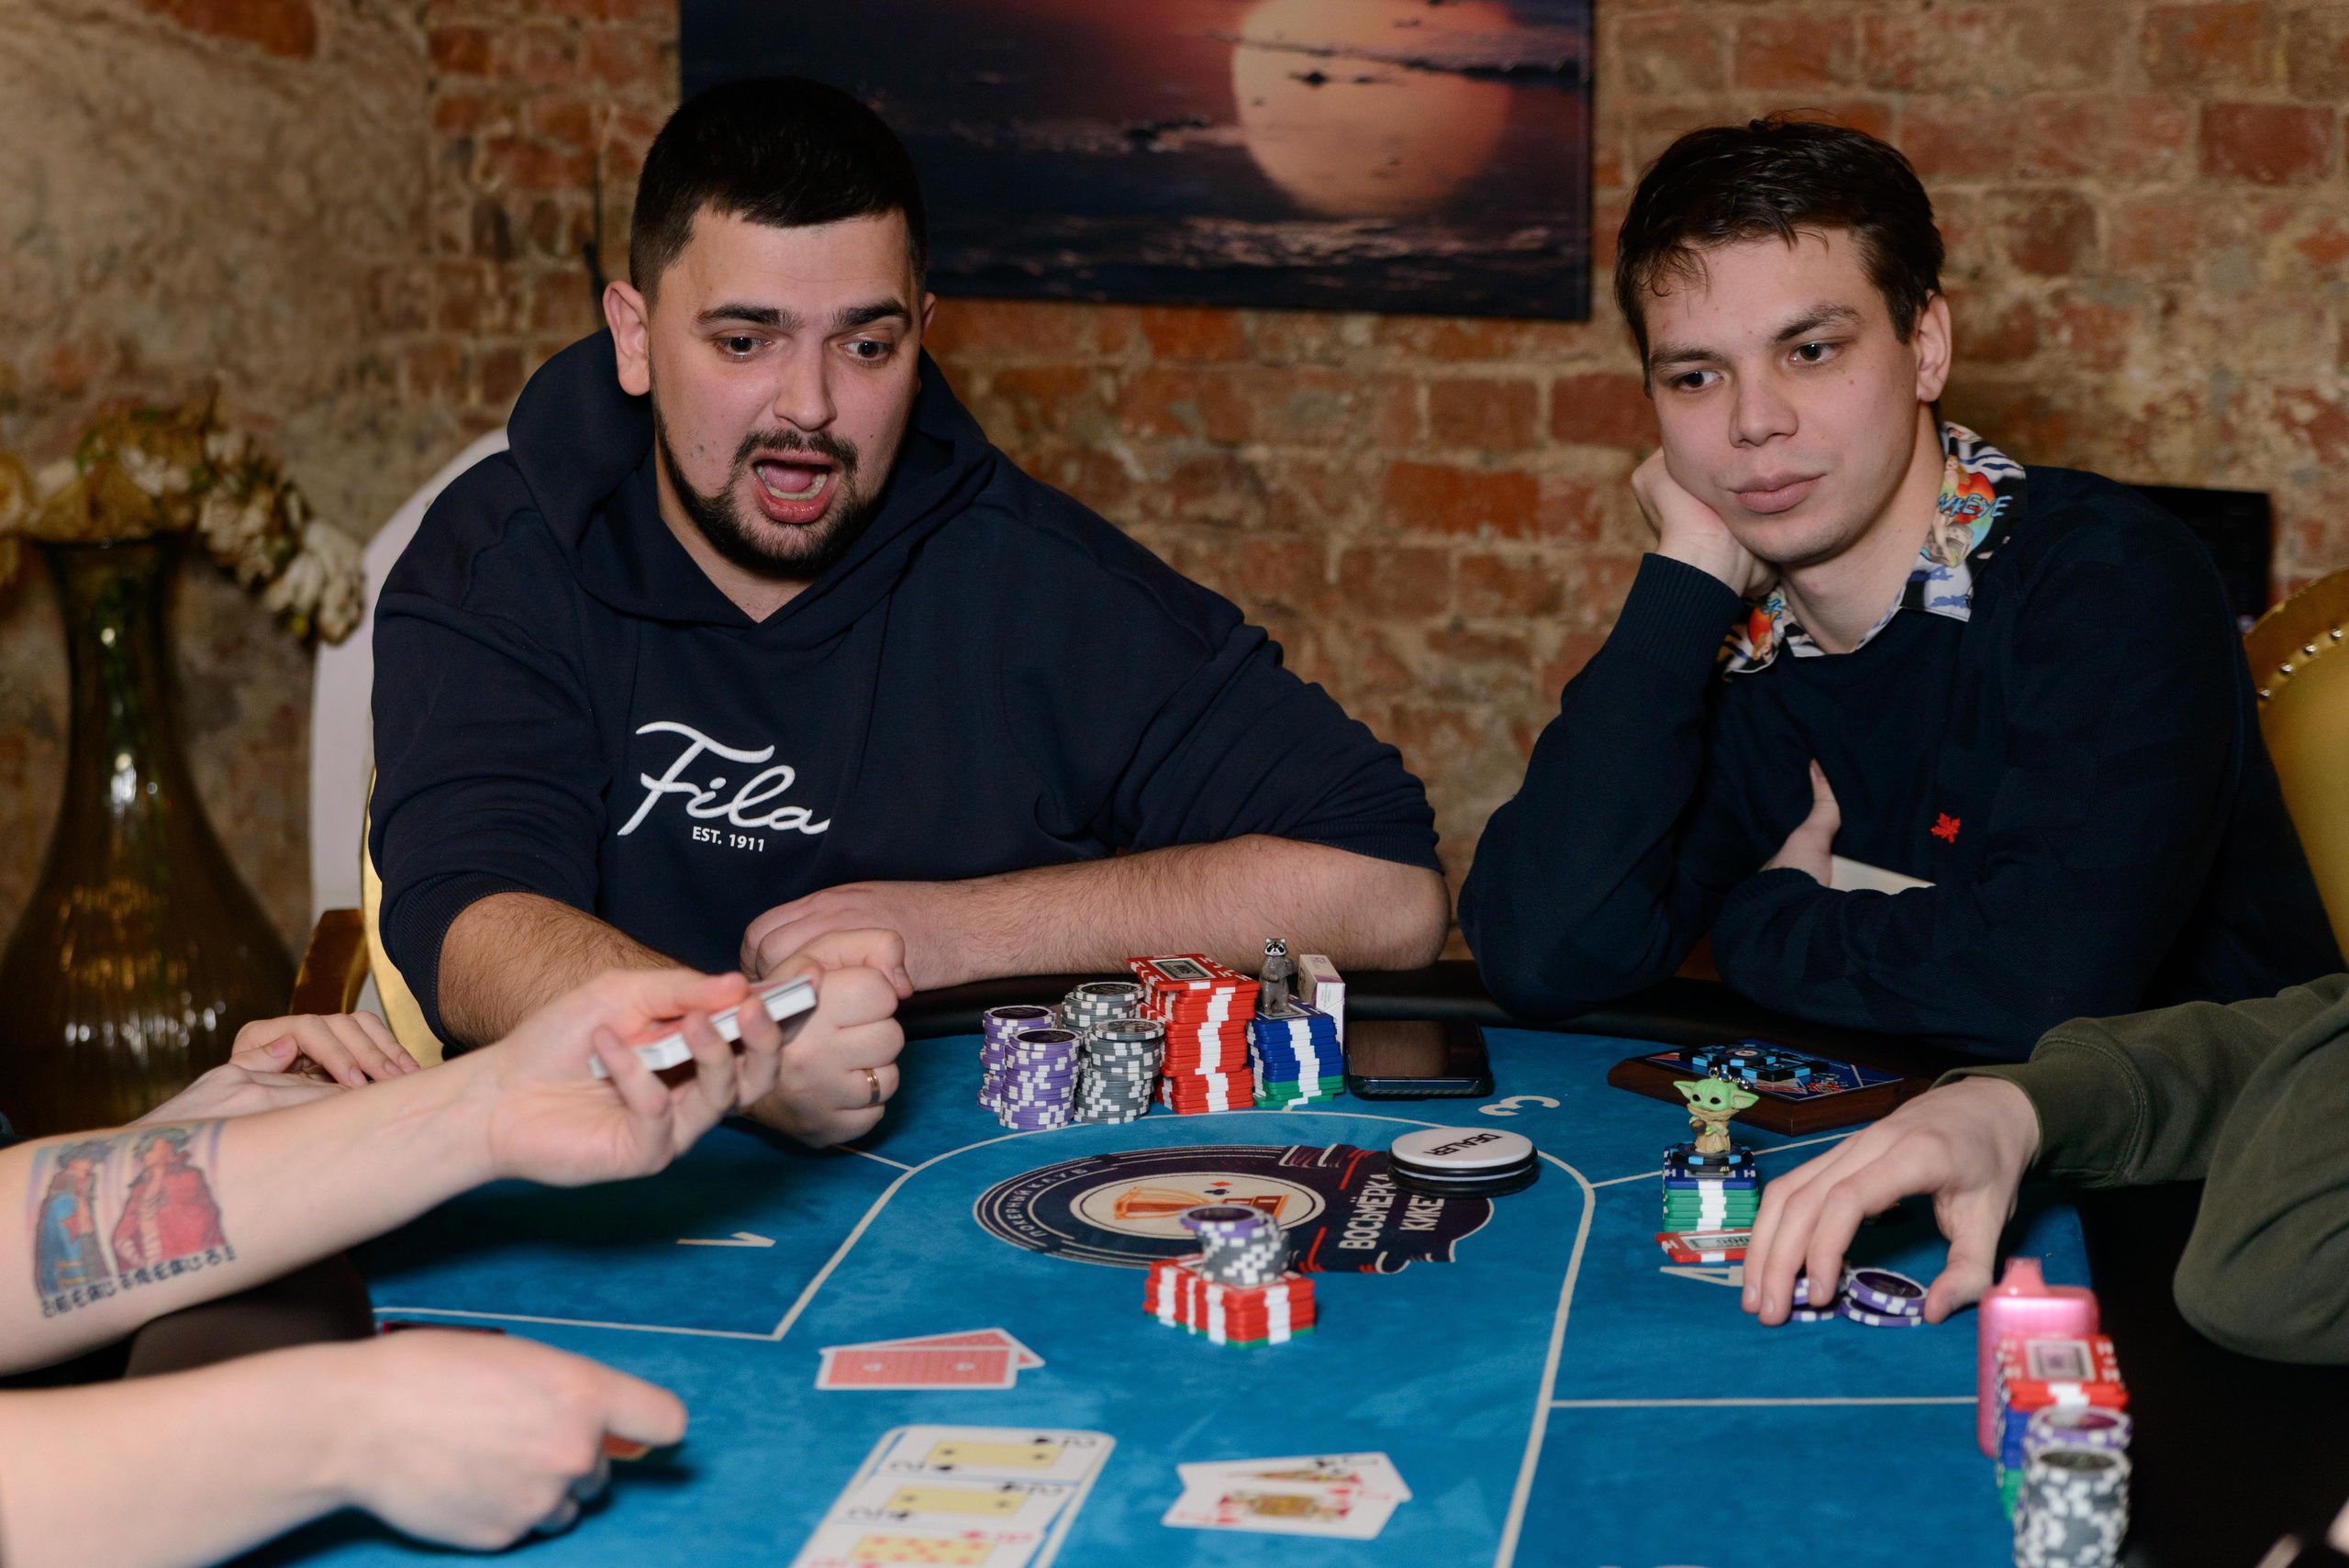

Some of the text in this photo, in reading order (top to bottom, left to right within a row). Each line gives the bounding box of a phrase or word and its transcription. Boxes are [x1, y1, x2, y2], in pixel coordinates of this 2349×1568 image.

[617, 720, 831, 836] Fila
[692, 826, 765, 852] EST. 1911
[1478, 1095, 1561, 1117] 3
[1423, 1133, 1503, 1156] DEALER
[1719, 1165, 1731, 1173] VIP
[1338, 1173, 1397, 1250] ВОСЬМЁРКА
[1399, 1195, 1445, 1231] КИКЕ
[675, 1230, 776, 1248] 1
